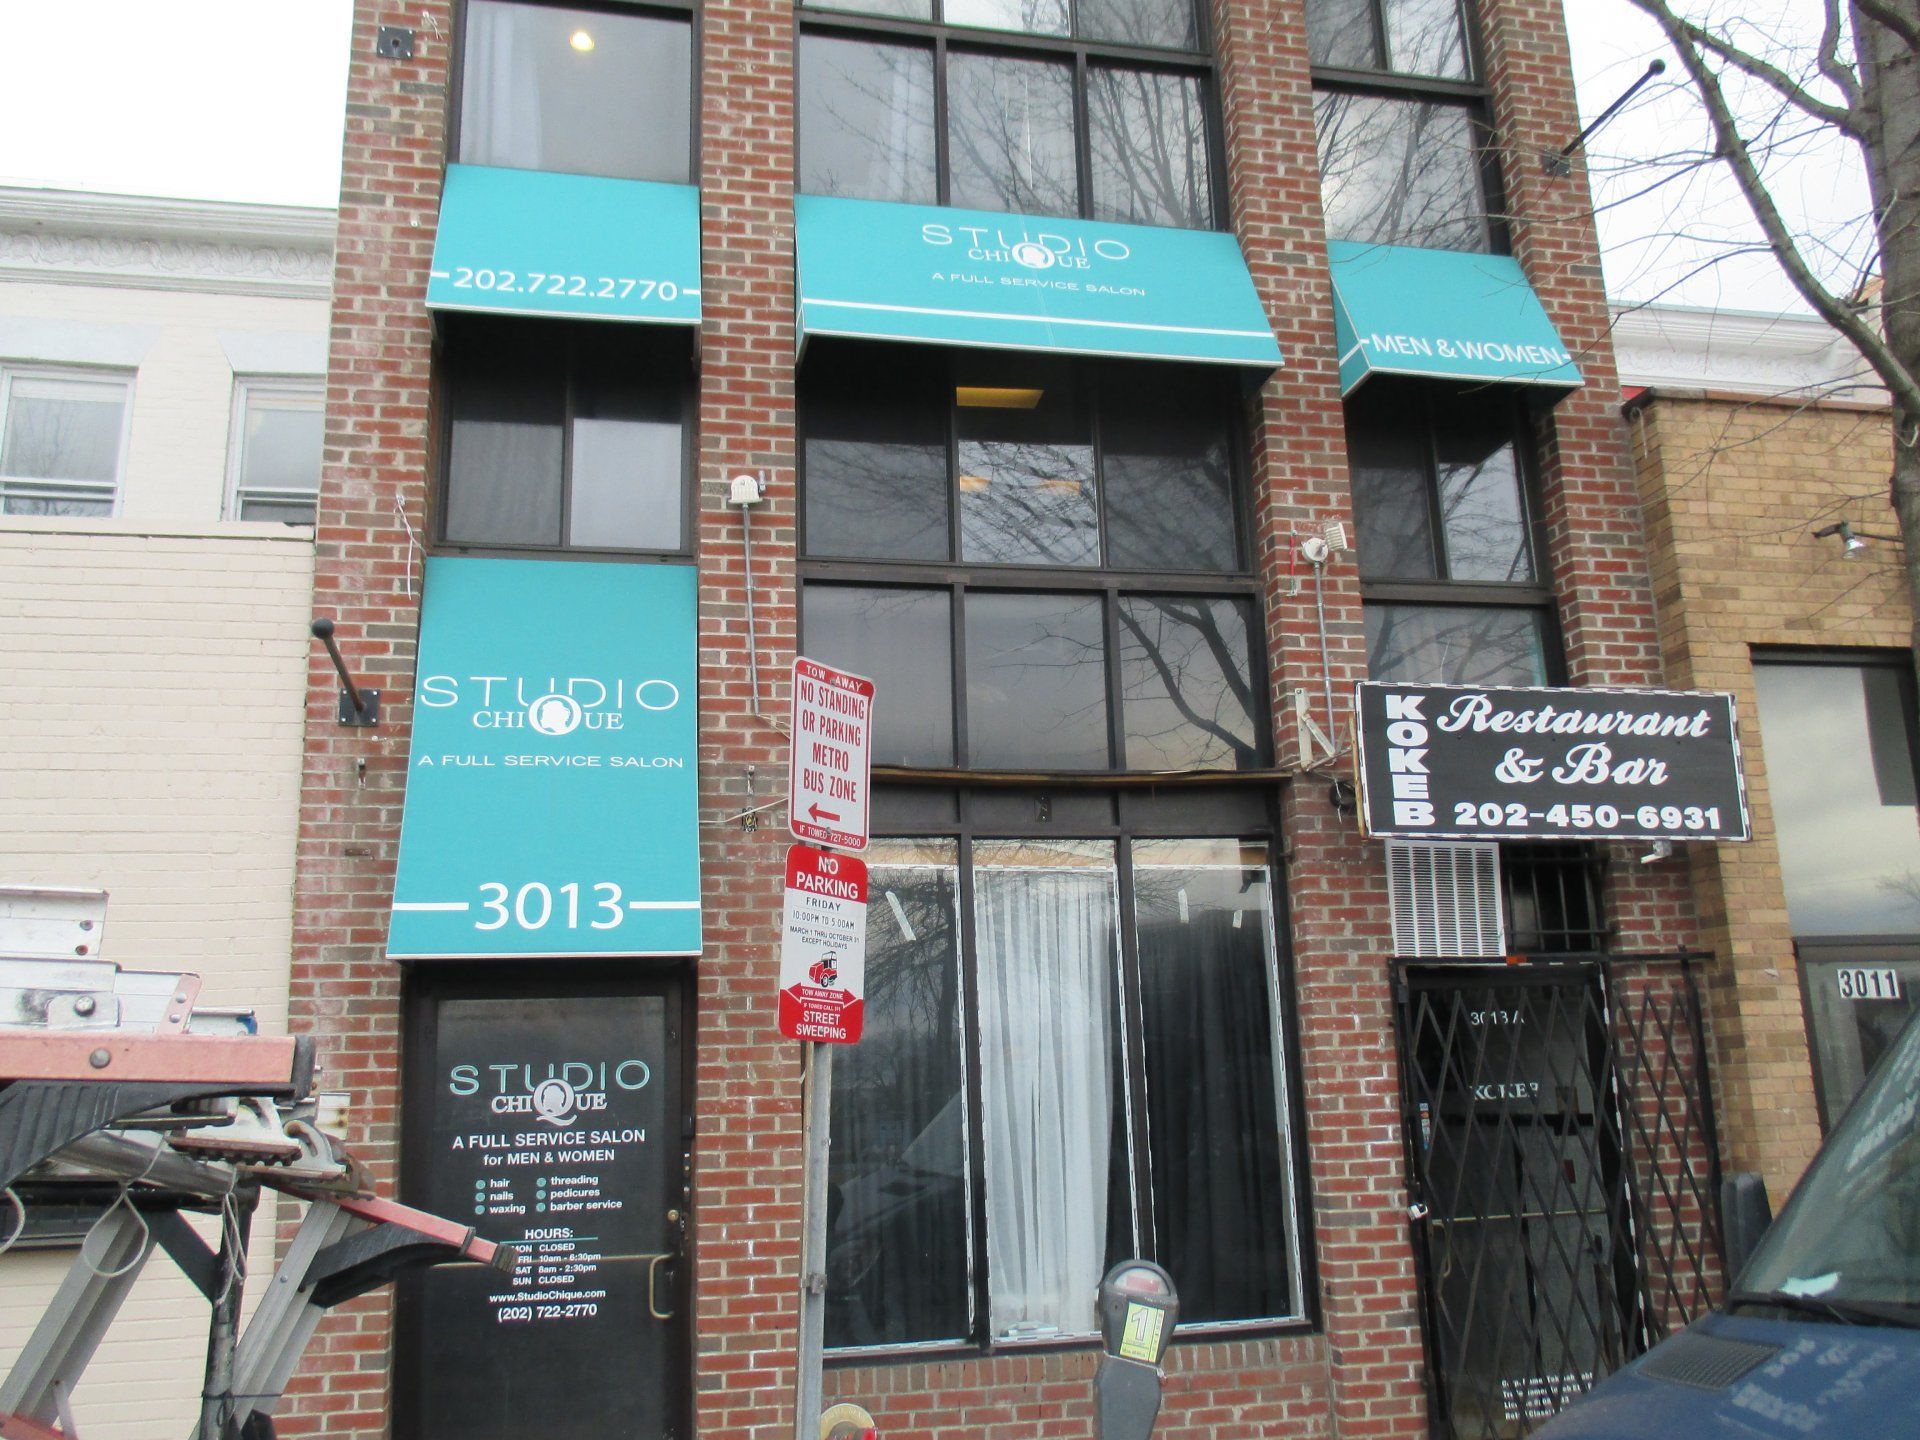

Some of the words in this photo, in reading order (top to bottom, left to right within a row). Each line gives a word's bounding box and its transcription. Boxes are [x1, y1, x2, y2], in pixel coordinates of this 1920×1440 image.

[922, 223, 1130, 261] STUDIO
[453, 266, 678, 302] 202.722.2770
[932, 272, 944, 280] A
[950, 273, 994, 284] FULL
[1000, 276, 1080, 292] SERVICE
[1086, 284, 1146, 297] SALON
[1371, 334, 1433, 357] MEN
[1436, 339, 1458, 358] &
[1456, 340, 1563, 365] WOMEN
[806, 664, 826, 680] TOW
[835, 675, 863, 693] AWAY
[420, 675, 680, 711] STUDIO
[801, 680, 814, 703] NO
[818, 686, 865, 720] STANDING
[1436, 694, 1711, 738] Restaurant
[802, 709, 815, 732] OR
[820, 716, 861, 747] PARKING
[418, 755, 434, 766] A
[442, 755, 496, 766] FULL
[504, 755, 602, 767] SERVICE
[609, 756, 683, 768] SALON
[812, 742, 849, 772] METRO
[1385, 694, 1435, 826] KOKEB
[1494, 747, 1544, 784] &
[1552, 742, 1668, 785] Bar
[803, 768, 824, 794] BUS
[829, 775, 857, 803] ZONE
[1454, 803, 1720, 830] 202-450-6931
[800, 824, 805, 835] IF
[829, 830, 861, 847] 727-5000
[818, 856, 839, 874] NO
[796, 871, 859, 899] PARKING
[474, 882, 624, 930] 3013
[806, 897, 841, 911] FRIDAY
[822, 916, 829, 925] TO
[790, 925, 809, 934] MARCH
[814, 930, 828, 938] THRU
[828, 932, 852, 942] OCTOBER
[801, 936, 822, 945] EXCEPT
[822, 940, 848, 950] HOLIDAYS
[802, 988, 814, 996] TOW
[814, 990, 829, 998] AWAY
[1840, 970, 1896, 997] 3011
[803, 1011, 840, 1026] STREET
[796, 1023, 847, 1039] SWEEPING
[450, 1059, 650, 1096] STUDIO
[491, 1078, 608, 1127] CHIQUE
[452, 1136, 464, 1149] A
[469, 1134, 510, 1148] FULL
[515, 1131, 586, 1147] SERVICE
[590, 1129, 645, 1144] SALON
[483, 1154, 503, 1166] for
[507, 1152, 540, 1165] MEN
[544, 1152, 554, 1163] &
[558, 1149, 615, 1163] WOMEN
[490, 1179, 510, 1188] hair
[550, 1175, 598, 1186] threading
[490, 1192, 514, 1200] nails
[550, 1188, 600, 1200] pedicures
[490, 1204, 526, 1215] waxing
[550, 1201, 584, 1211] barber
[586, 1200, 623, 1210] service
[525, 1228, 574, 1240] HOURS:
[539, 1243, 575, 1252] CLOSED
[518, 1255, 532, 1263] FRI
[569, 1253, 601, 1263] 6:30pm
[515, 1266, 532, 1274] SAT
[538, 1265, 557, 1273] 8am
[565, 1264, 597, 1273] 2:30pm
[512, 1277, 532, 1286] SUN
[538, 1275, 575, 1284] CLOSED
[489, 1289, 606, 1303] www.StudioChique.com
[498, 1307, 532, 1323] (202)
[536, 1304, 598, 1318] 722-2770
[1131, 1307, 1149, 1342] 1
